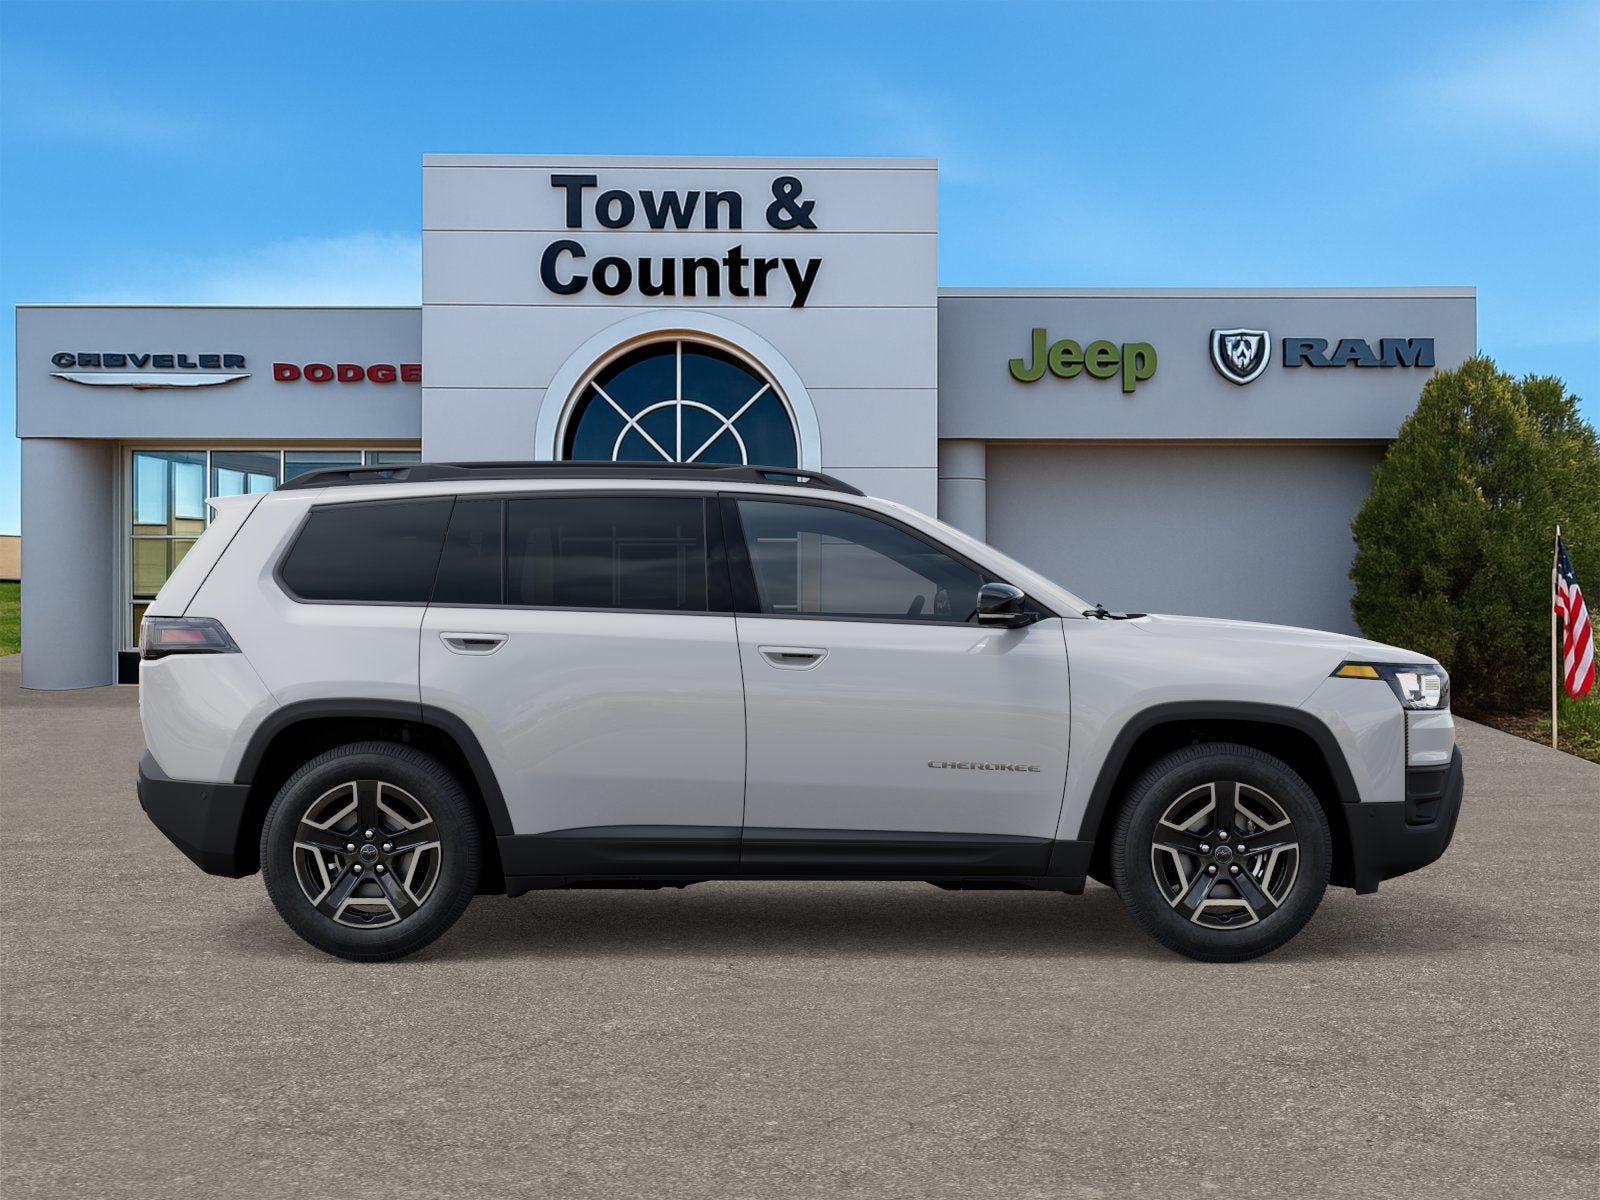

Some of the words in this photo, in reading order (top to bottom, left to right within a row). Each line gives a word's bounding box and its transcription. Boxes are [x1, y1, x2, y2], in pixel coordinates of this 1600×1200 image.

[551, 174, 742, 229] Town
[765, 176, 818, 230] &
[540, 240, 822, 308] Country
[272, 362, 422, 382] DODGE
[1008, 327, 1157, 393] Jeep
[1282, 337, 1436, 368] RAM
[927, 760, 1041, 773] CHEROKEE
